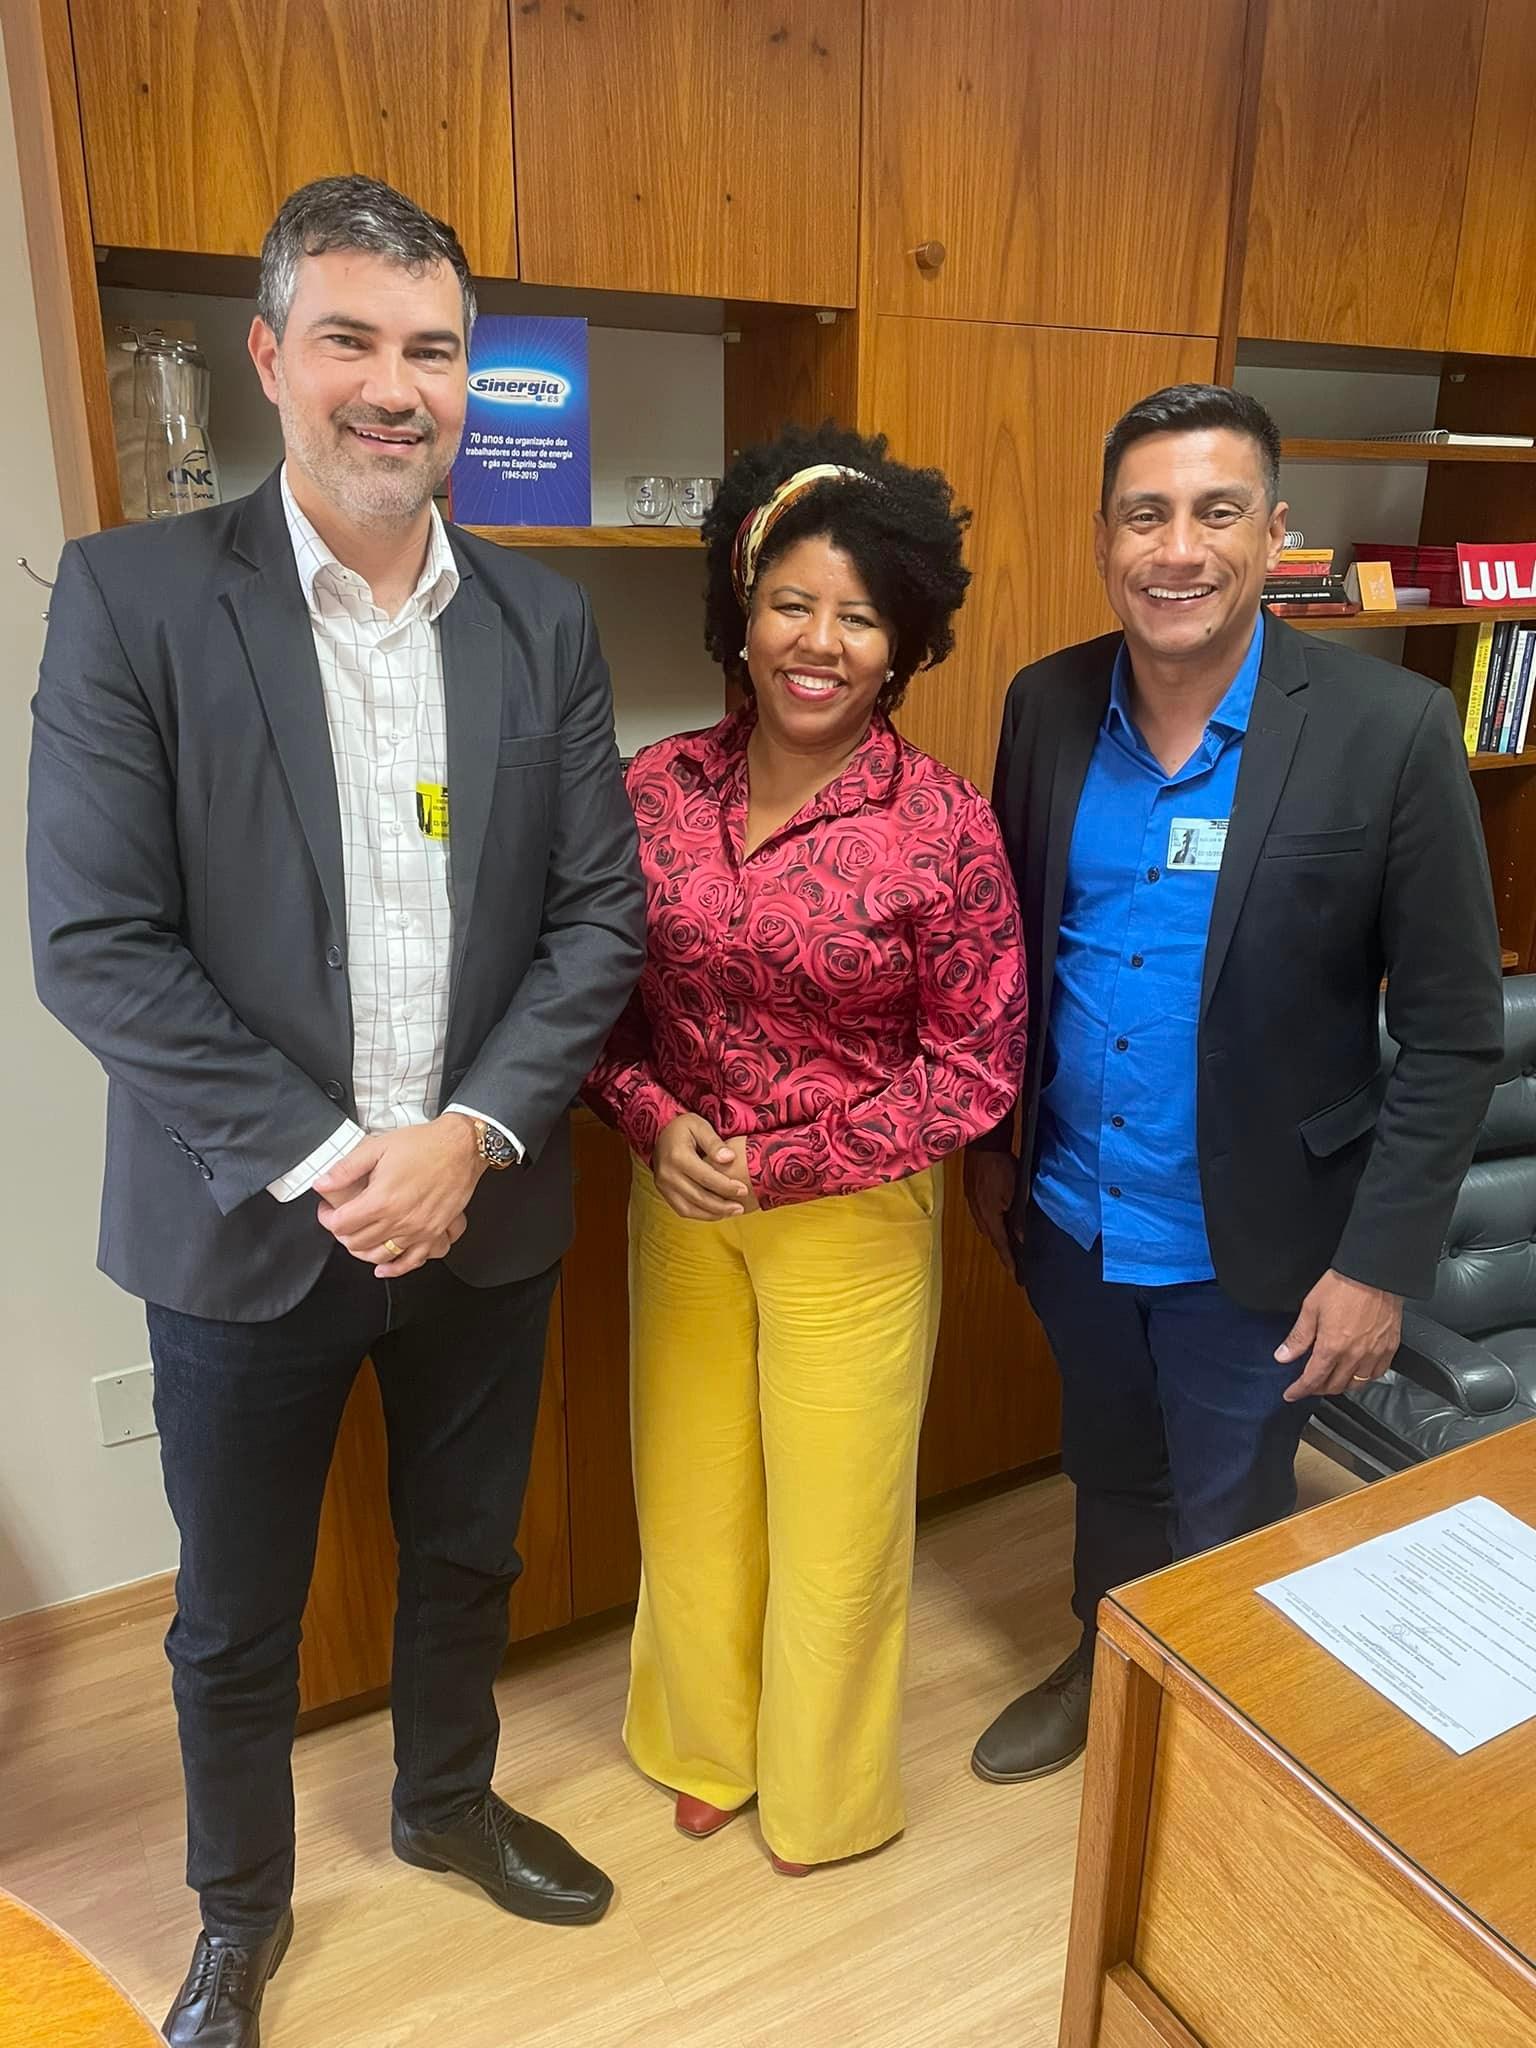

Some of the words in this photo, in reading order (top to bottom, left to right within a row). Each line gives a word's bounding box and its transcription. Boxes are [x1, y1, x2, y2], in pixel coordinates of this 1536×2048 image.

[476, 379, 559, 395] Sinergia
[547, 395, 559, 403] ES
[470, 432, 480, 444] 70
[482, 435, 504, 445] anos
[505, 436, 514, 445] da
[515, 437, 554, 447] organização
[555, 438, 568, 446] dos
[465, 447, 510, 457] trabalhadores
[511, 448, 520, 457] do
[521, 449, 538, 457] setor
[540, 449, 547, 457] de
[548, 450, 573, 460] energia
[537, 460, 557, 469] Santo
[501, 471, 539, 481] (1945-2015)
[1462, 560, 1536, 601] LUL
